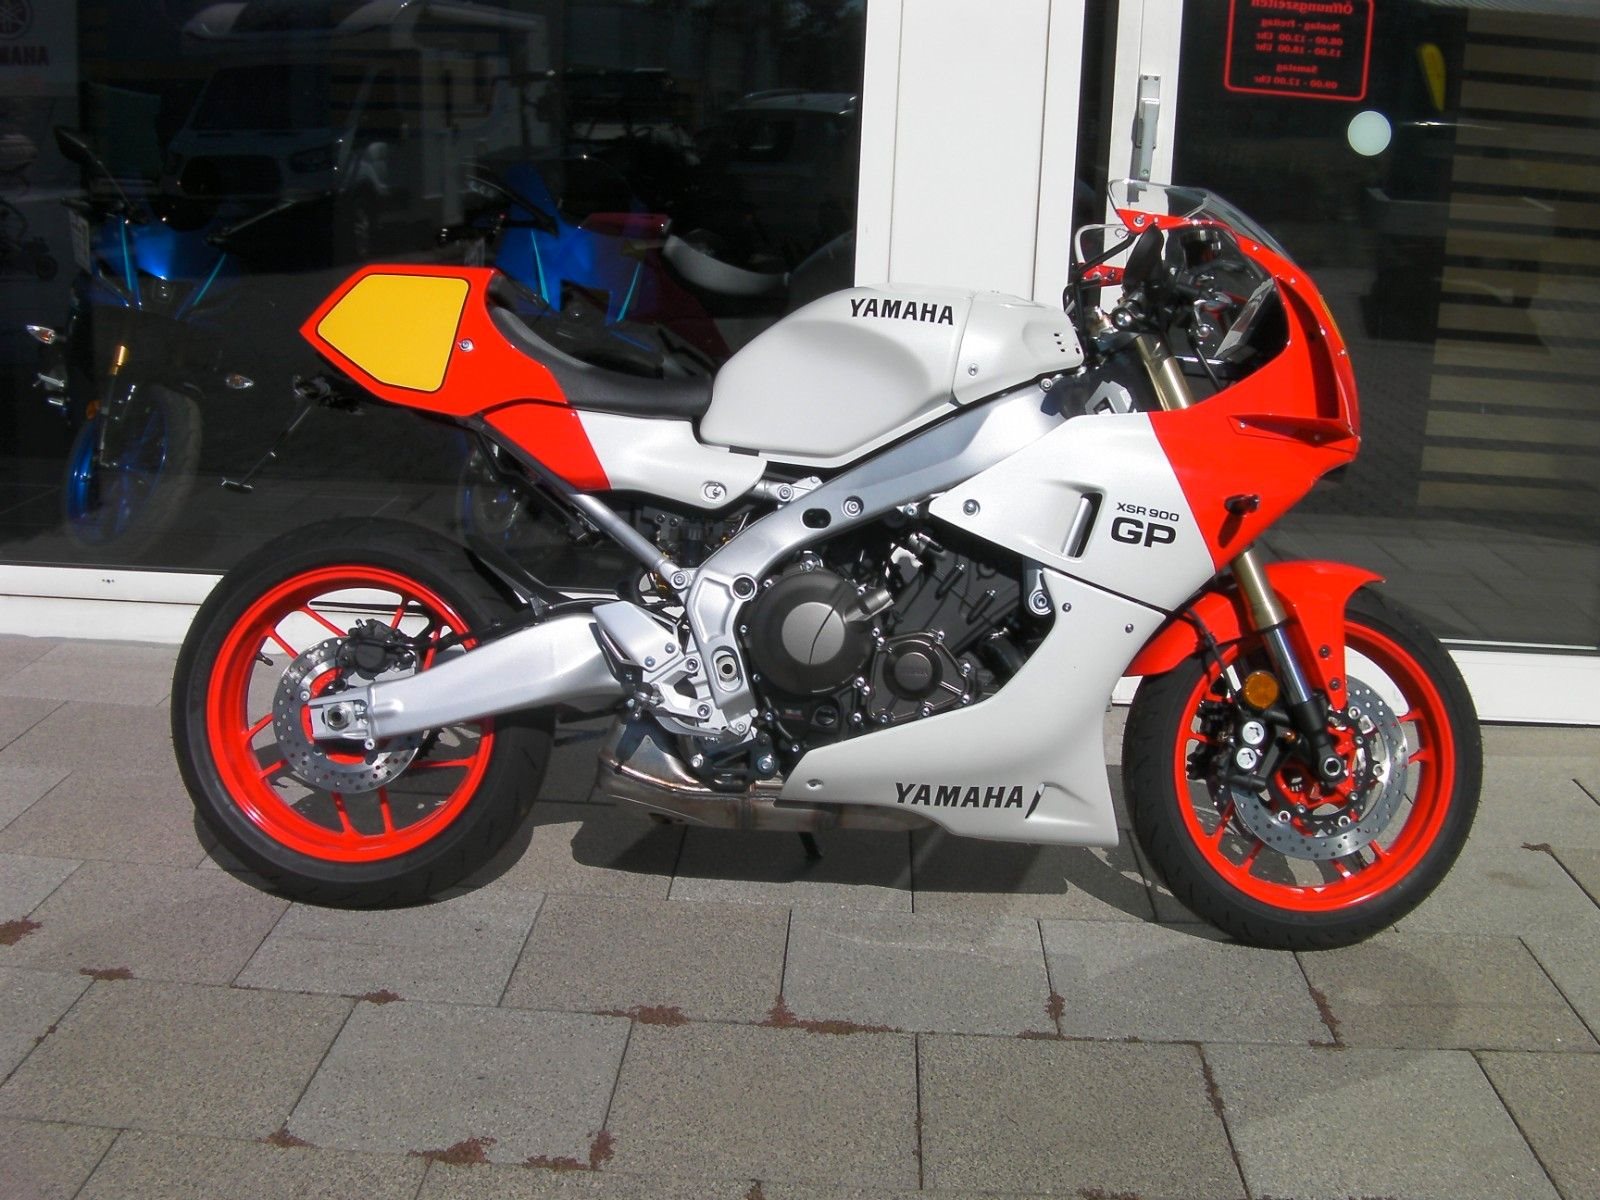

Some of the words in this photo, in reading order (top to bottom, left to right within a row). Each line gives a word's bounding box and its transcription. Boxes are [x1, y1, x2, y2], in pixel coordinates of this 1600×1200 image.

[850, 298, 954, 326] YAMAHA
[1111, 516, 1177, 548] GP
[895, 782, 1024, 809] YAMAHA
